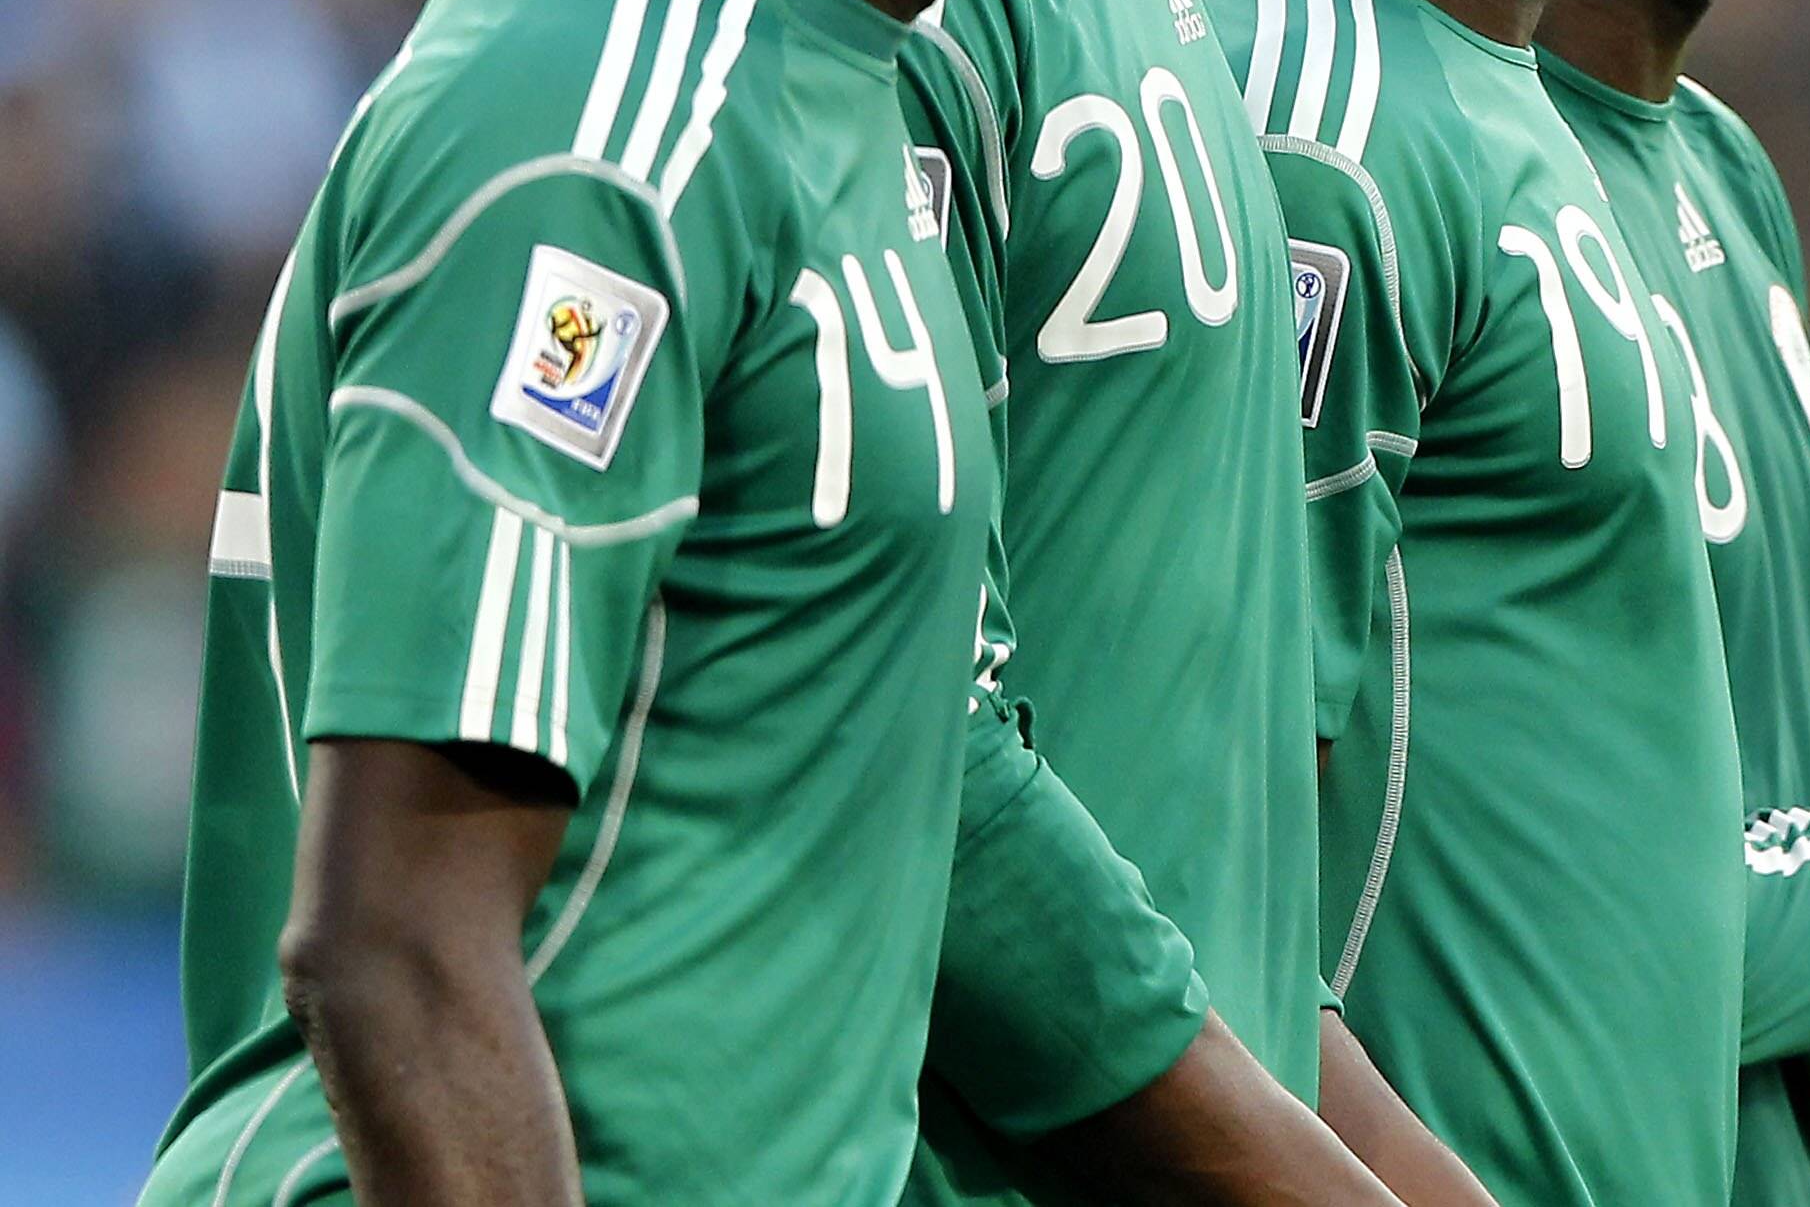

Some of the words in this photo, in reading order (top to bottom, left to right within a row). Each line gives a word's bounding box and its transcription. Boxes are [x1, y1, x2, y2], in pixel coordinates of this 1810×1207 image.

[1031, 66, 1239, 364] 20
[1498, 204, 1667, 469] 19
[788, 249, 956, 529] 14
